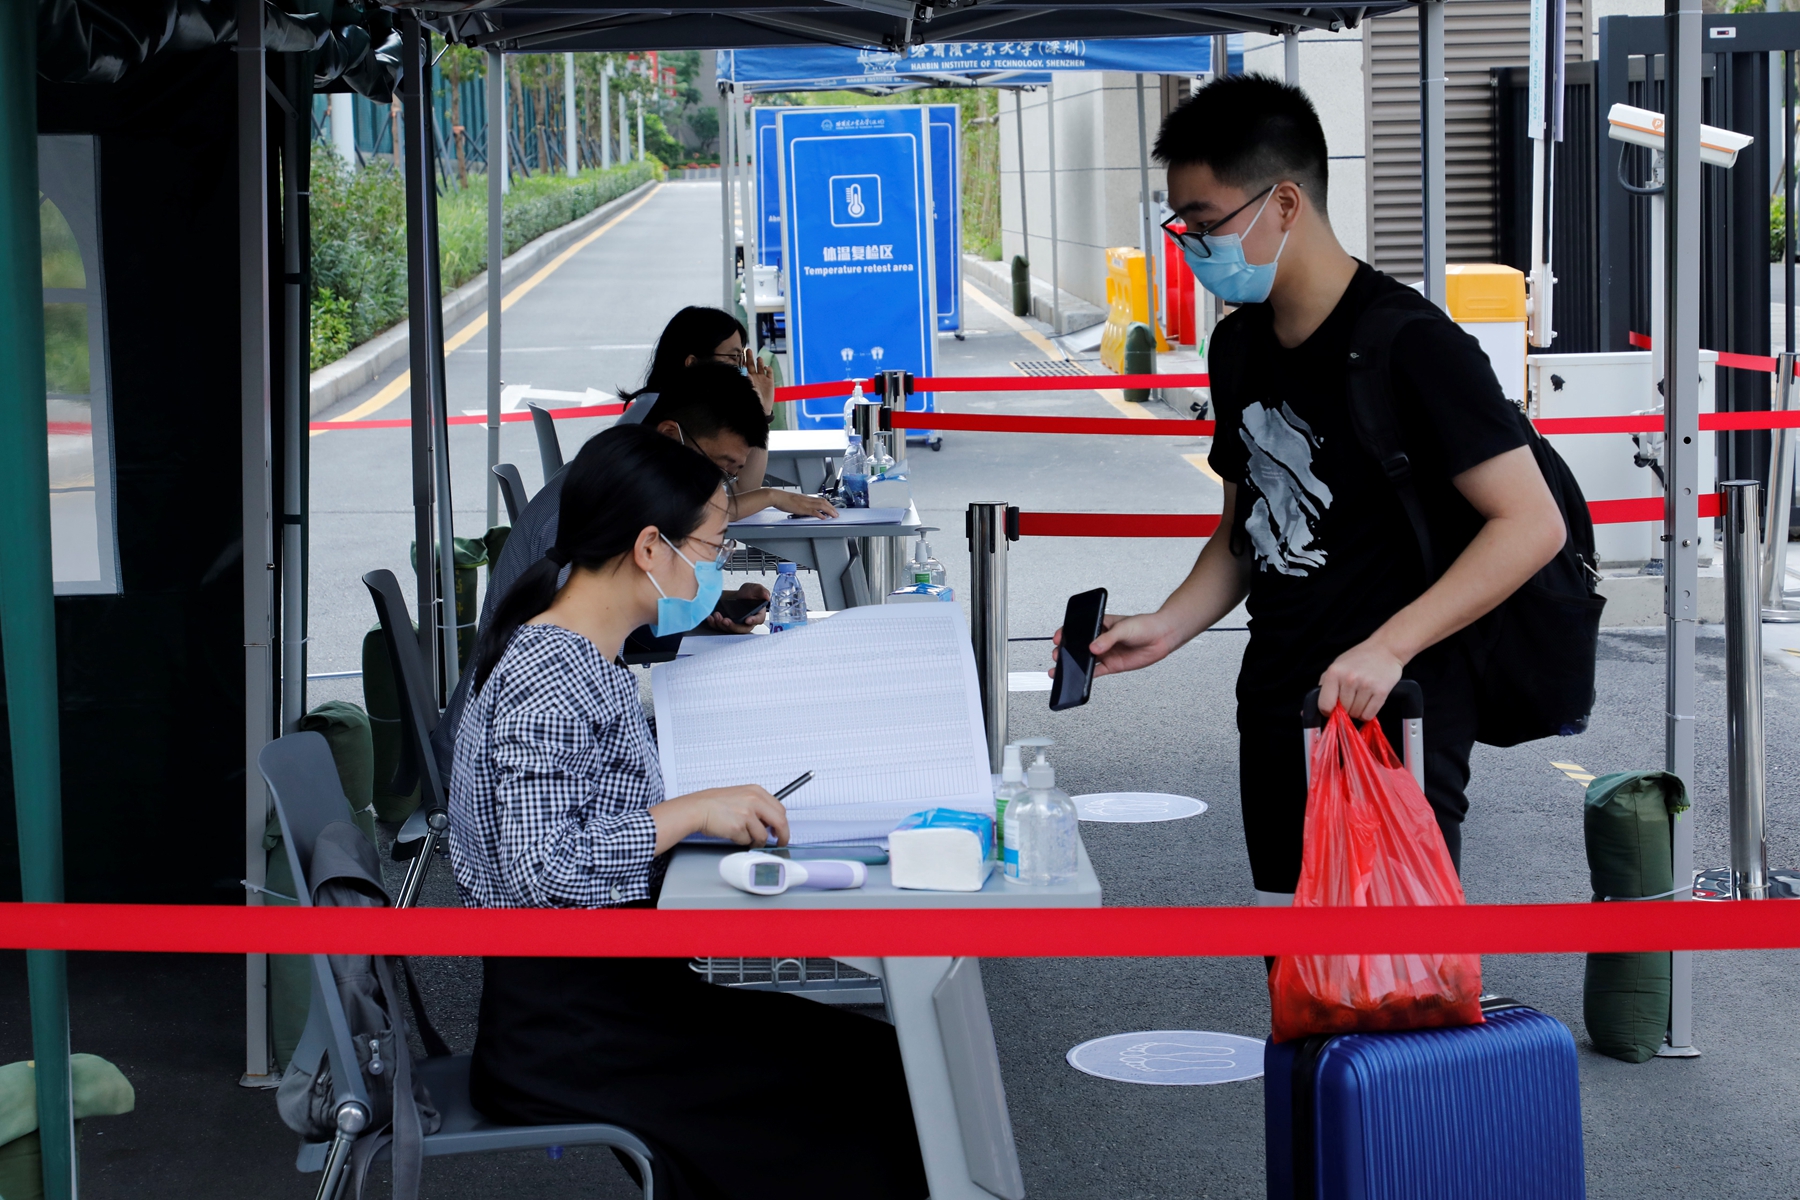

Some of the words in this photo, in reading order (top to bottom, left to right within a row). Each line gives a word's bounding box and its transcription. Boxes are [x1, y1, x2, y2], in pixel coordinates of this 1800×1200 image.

[911, 62, 940, 71] HARBIN
[942, 60, 978, 70] INSTITUTE
[980, 60, 991, 68] OF
[1046, 59, 1085, 68] SHENZHEN
[823, 244, 894, 262] 体温复检区
[804, 265, 861, 277] Temperature
[863, 263, 892, 273] retest
[892, 263, 914, 272] area
